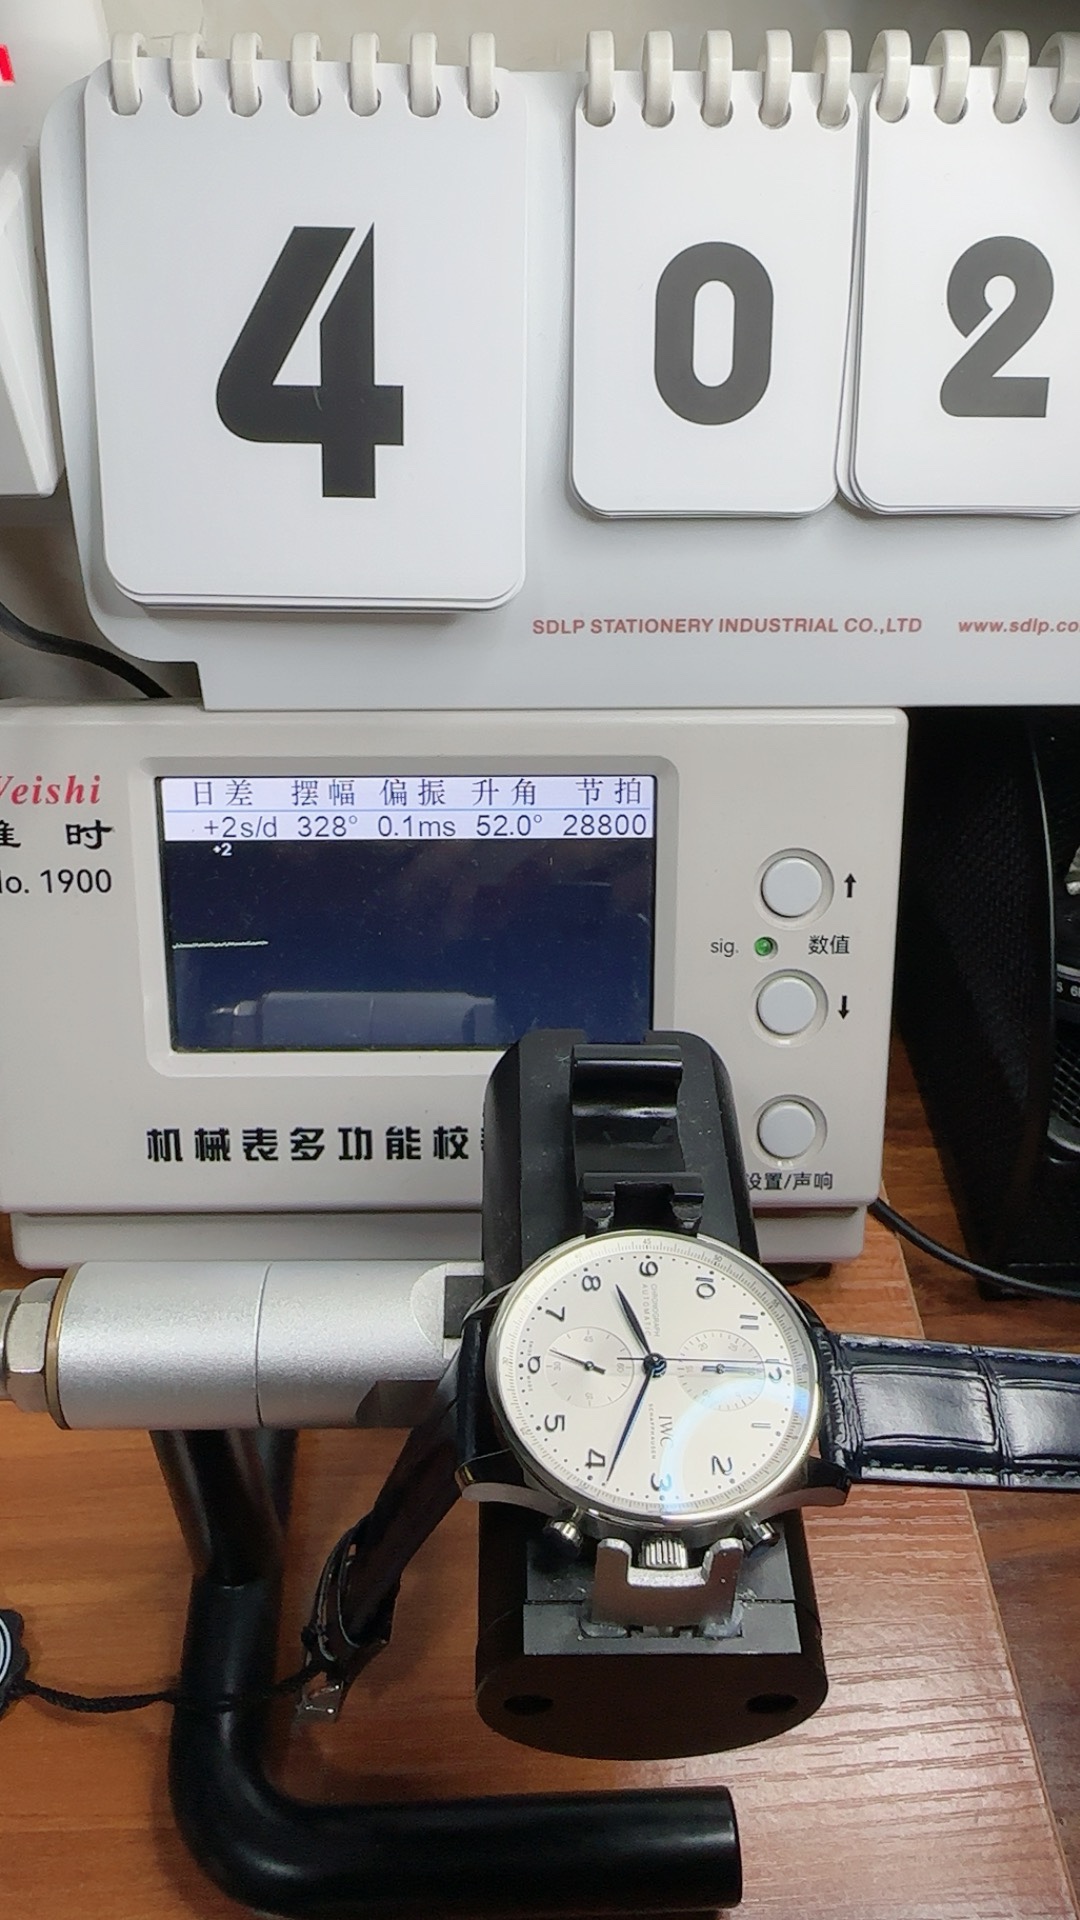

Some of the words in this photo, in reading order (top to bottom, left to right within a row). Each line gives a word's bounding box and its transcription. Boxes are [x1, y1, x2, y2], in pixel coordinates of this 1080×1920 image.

[216, 221, 404, 499] 4
[654, 240, 773, 426] 0
[939, 235, 1055, 418] 2
[532, 619, 586, 634] SDLP
[590, 618, 714, 634] STATIONERY
[718, 617, 839, 633] INDUSTRIAL
[844, 617, 922, 635] CO.,LTD
[958, 618, 1080, 636] www.sdlp.co
[193, 778, 254, 807] 日差
[290, 777, 358, 807] 摆幅
[378, 778, 446, 807] 偏振
[471, 778, 537, 807] 升角
[575, 778, 643, 807] 节拍
[203, 814, 279, 839] +2s/d
[297, 814, 359, 838] 328°
[377, 814, 457, 838] 0.1ms
[475, 814, 544, 838] 52.0°
[562, 813, 648, 837] 28800
[0, 868, 29, 895] o.
[40, 868, 112, 894] 1900
[709, 938, 740, 958] sig.
[807, 935, 851, 956] 数值
[146, 1125, 484, 1162] 机械表多功能校
[639, 1260, 659, 1278] 9
[581, 1275, 601, 1291] 8
[695, 1277, 716, 1299] 10
[545, 1306, 566, 1322] 7
[642, 1284, 652, 1336] AUTOMATIC
[739, 1314, 760, 1331] 11
[544, 1414, 566, 1433] 5
[658, 1415, 674, 1449] IWC
[584, 1448, 606, 1470] 4
[711, 1455, 733, 1476] 2
[650, 1472, 672, 1492] 3
